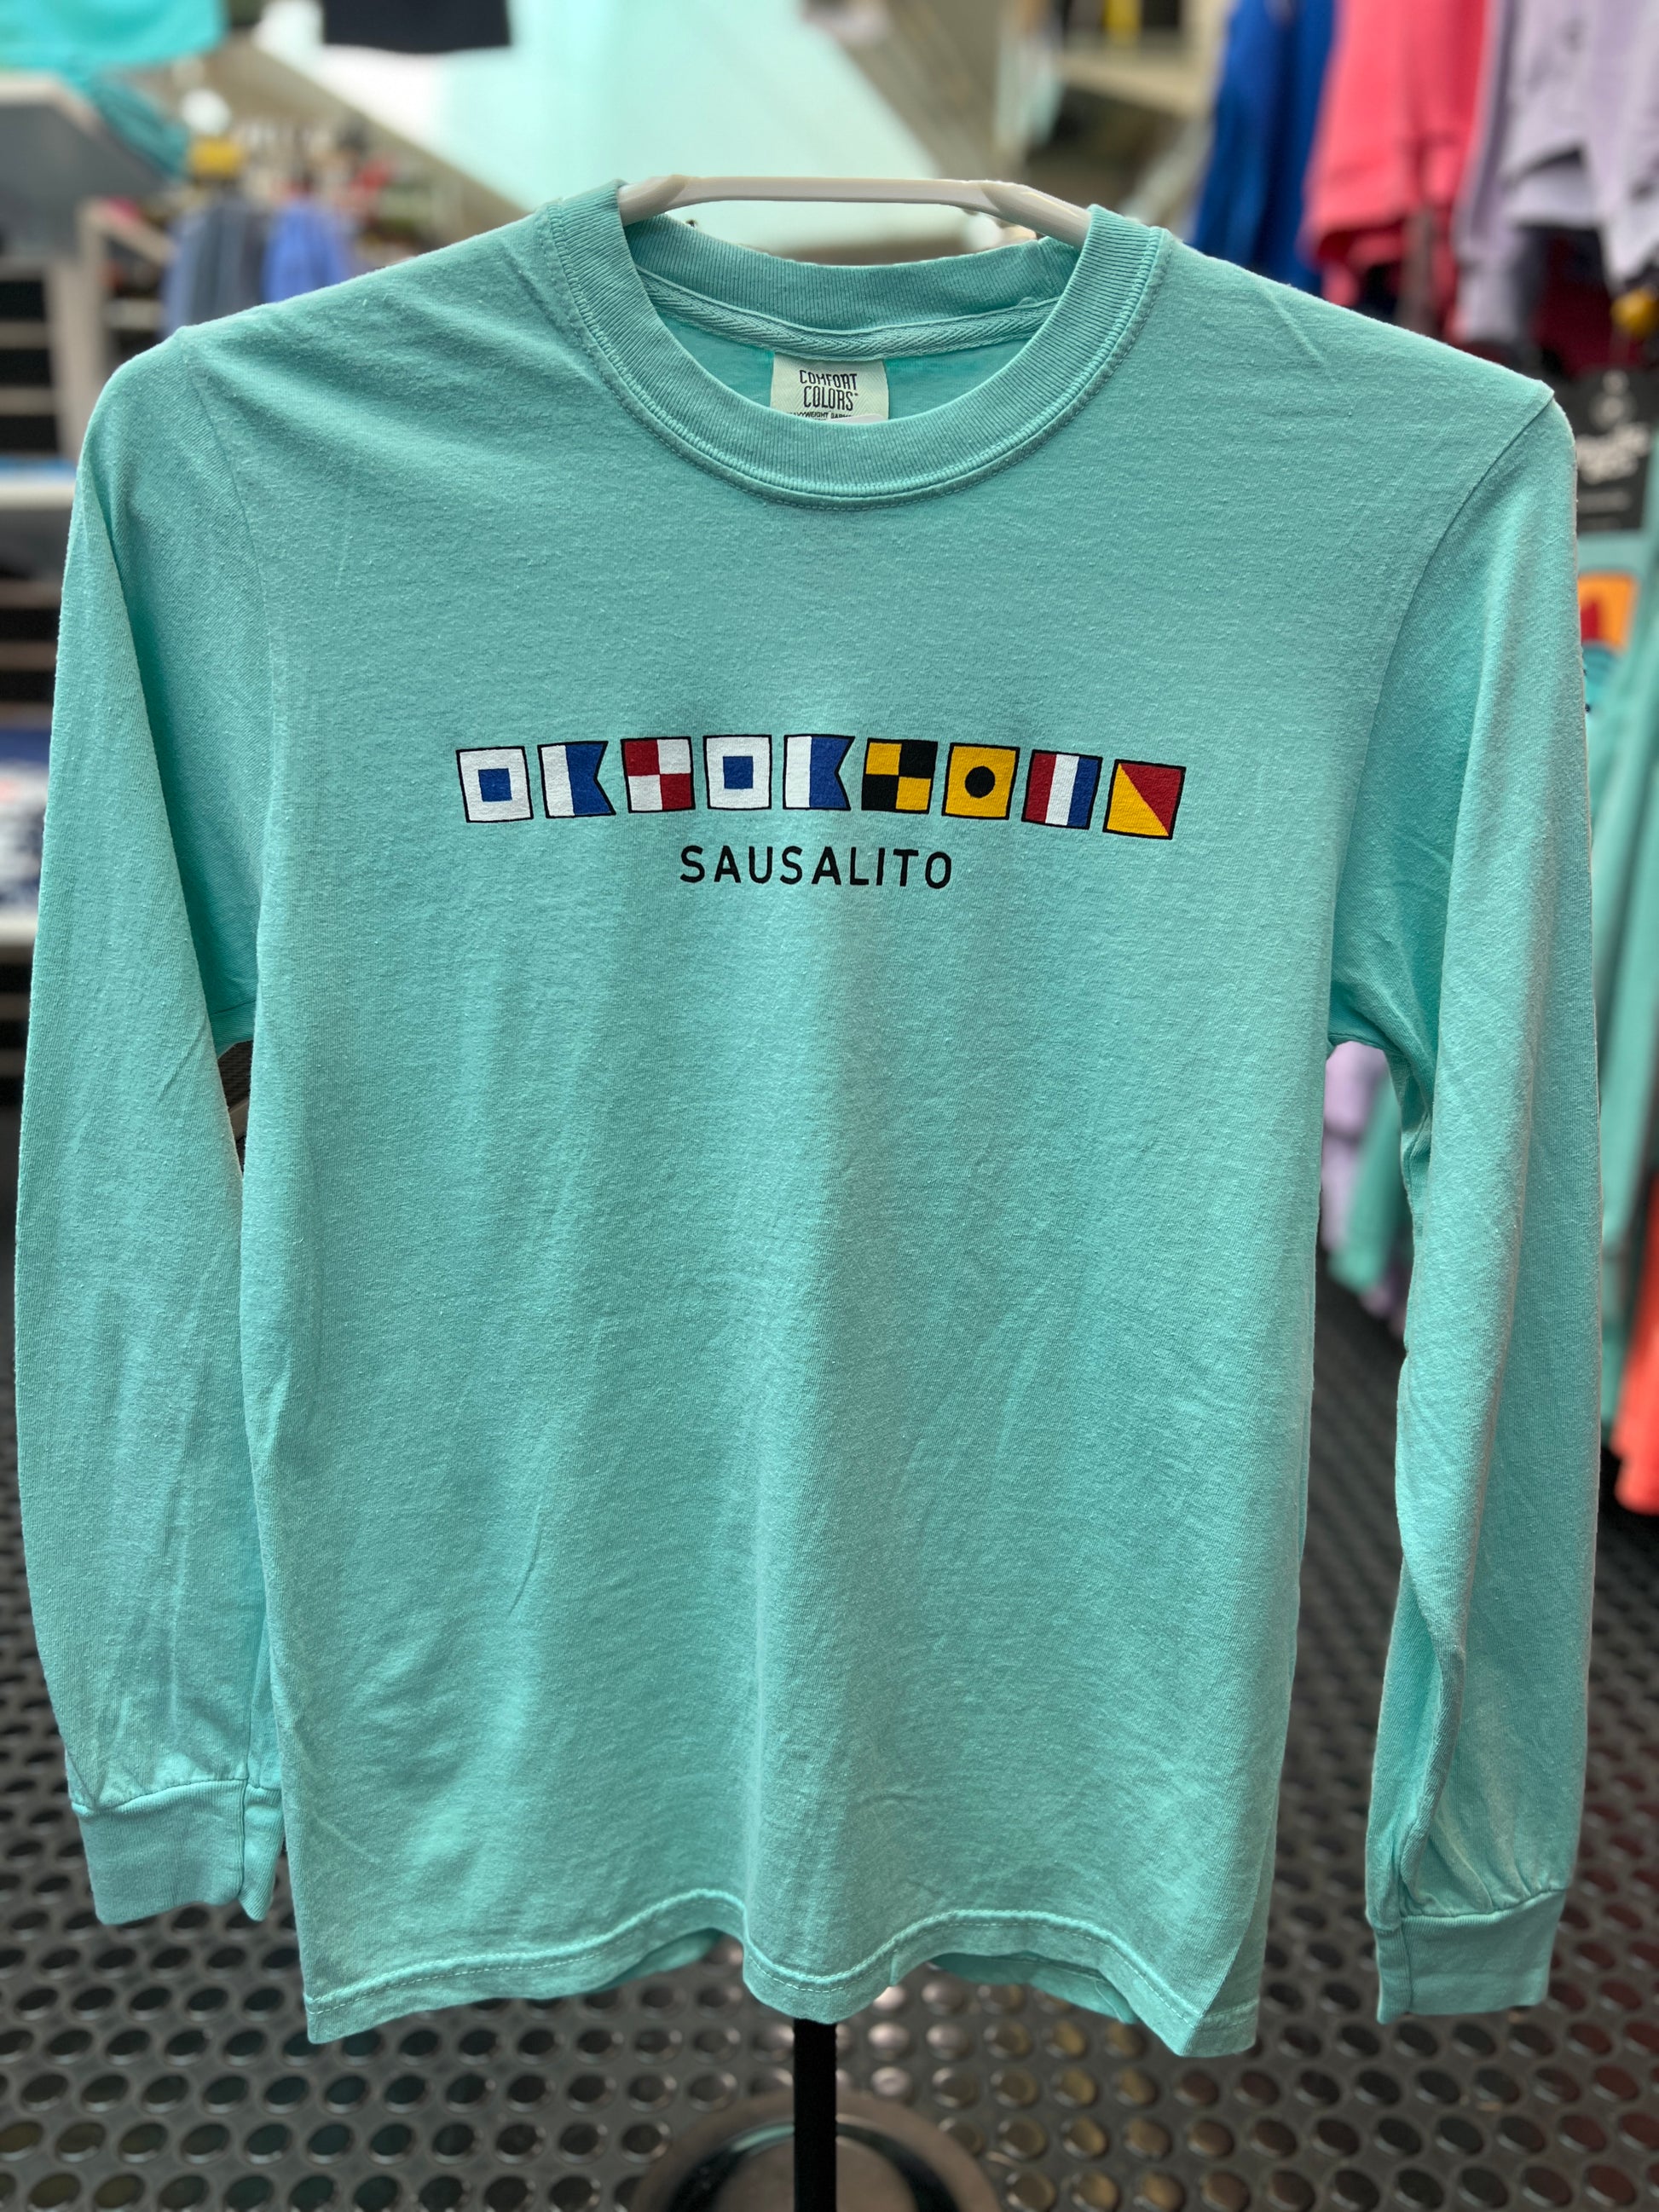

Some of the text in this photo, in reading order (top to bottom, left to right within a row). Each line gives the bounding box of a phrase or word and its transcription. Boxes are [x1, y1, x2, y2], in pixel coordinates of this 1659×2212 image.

[799, 369, 858, 390] COMFORT
[803, 385, 854, 412] COLORS
[679, 845, 952, 889] SAUSALITO
